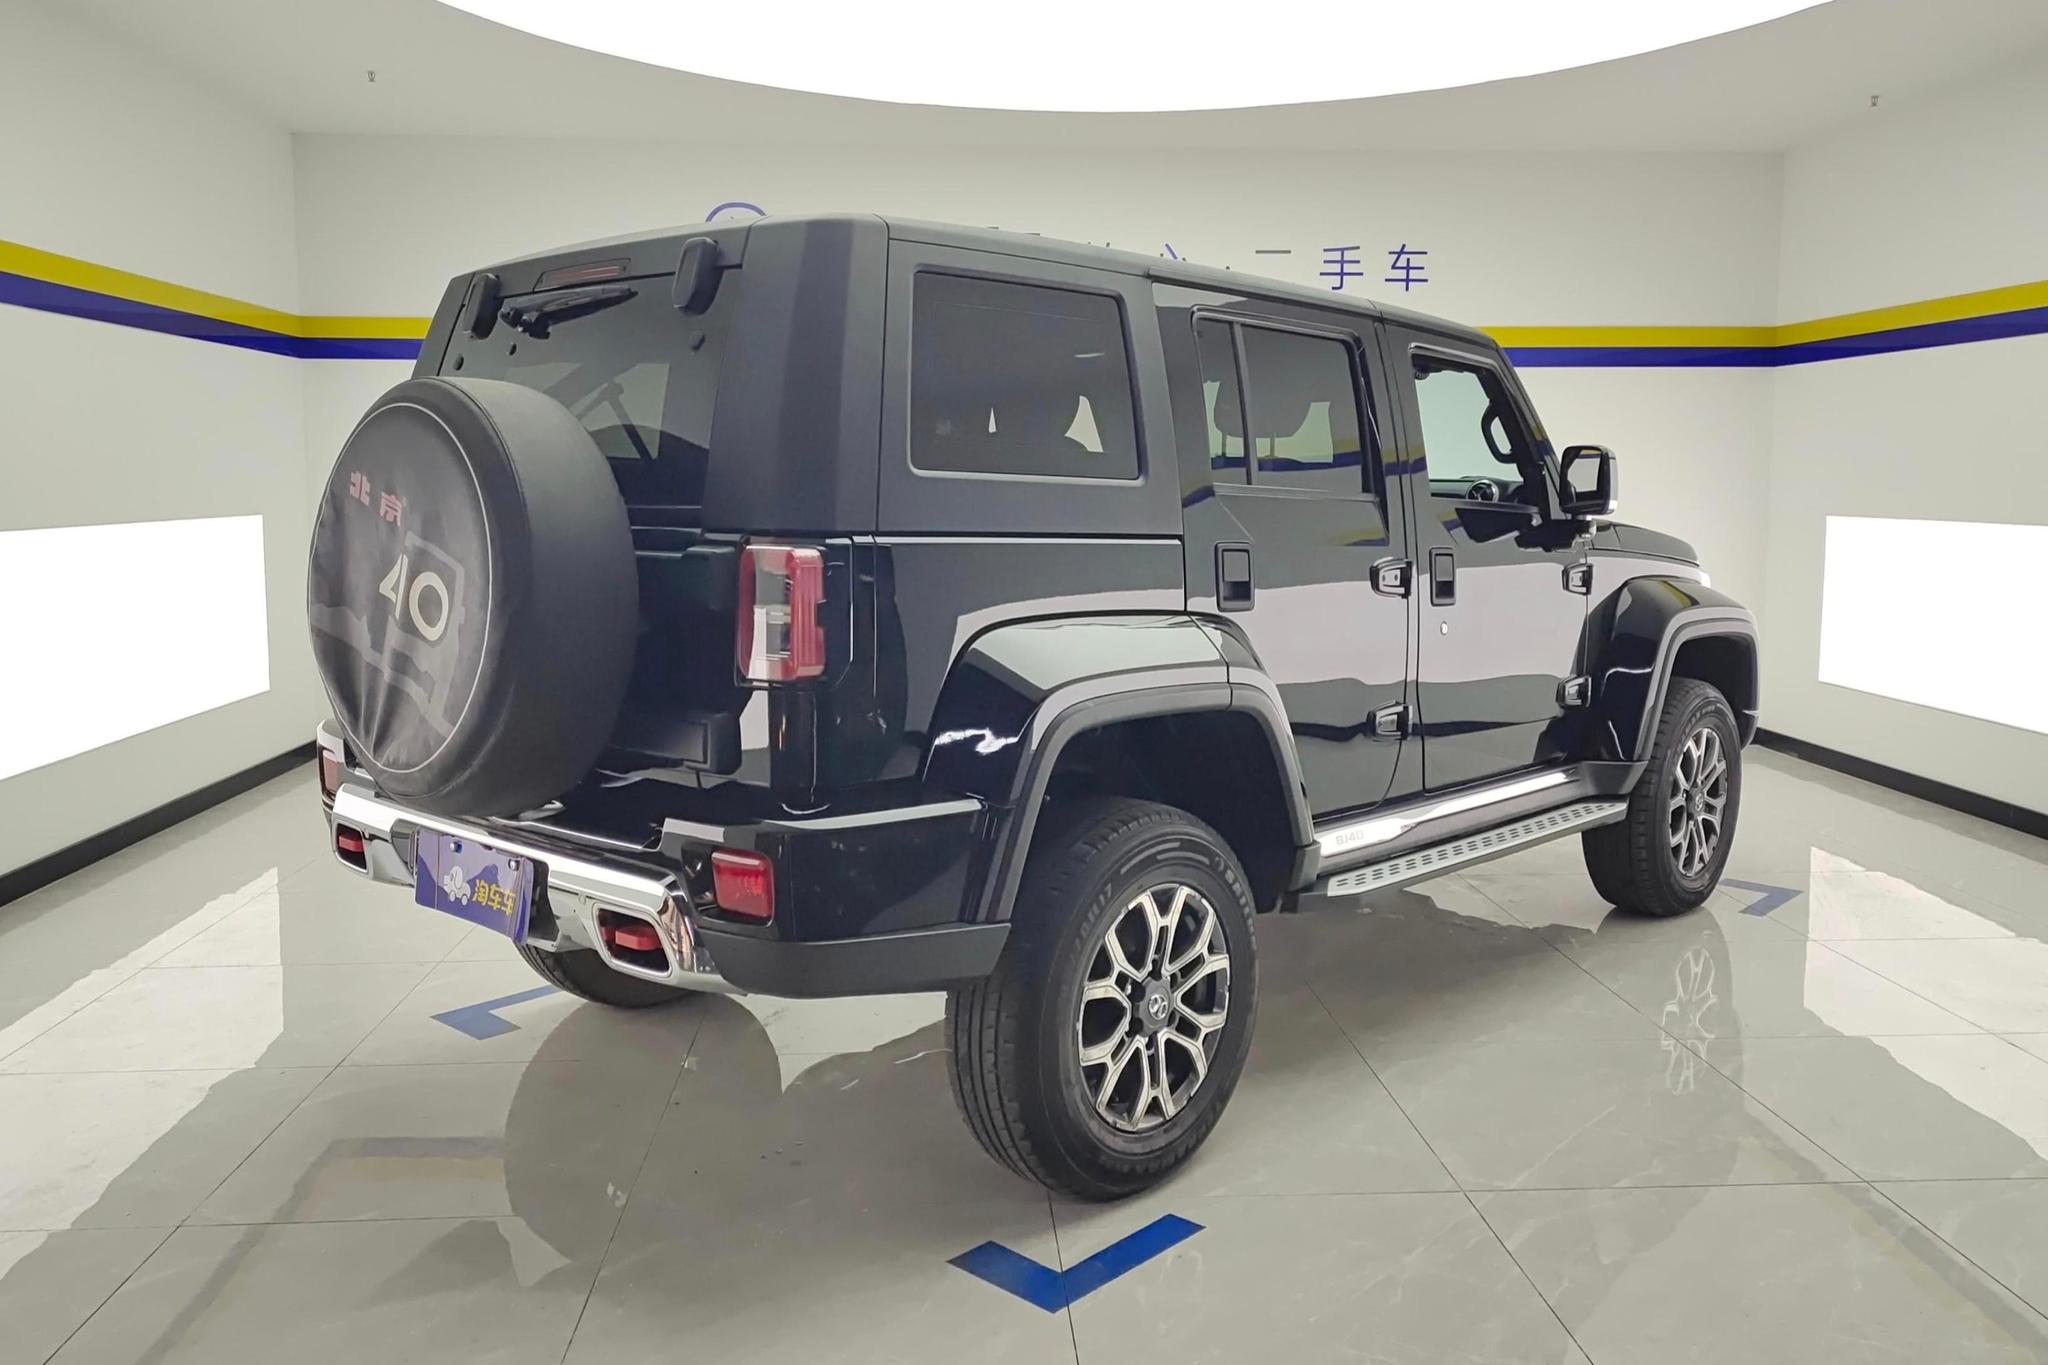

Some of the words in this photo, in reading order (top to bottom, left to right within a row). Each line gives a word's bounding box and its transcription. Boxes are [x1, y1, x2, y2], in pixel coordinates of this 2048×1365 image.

[350, 470, 404, 527] 北京
[378, 552, 450, 642] 40
[472, 879, 516, 916] 淘车车
